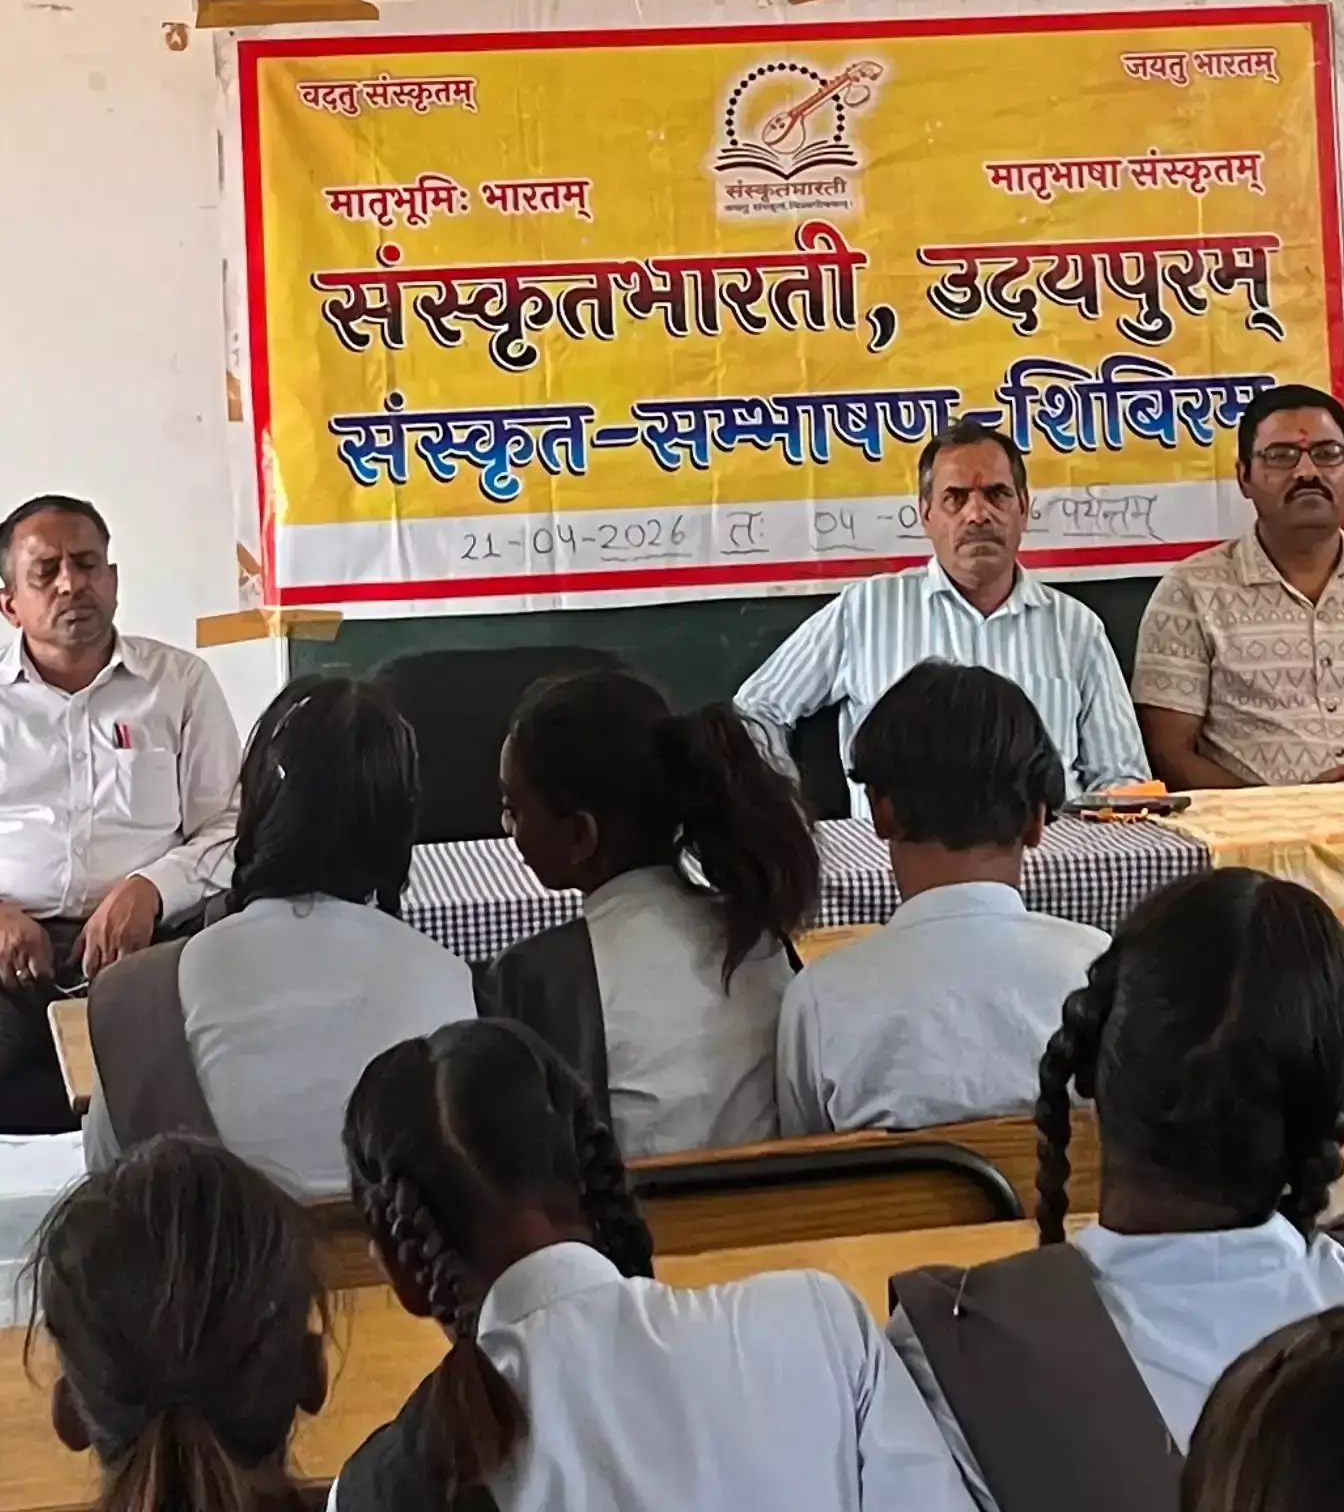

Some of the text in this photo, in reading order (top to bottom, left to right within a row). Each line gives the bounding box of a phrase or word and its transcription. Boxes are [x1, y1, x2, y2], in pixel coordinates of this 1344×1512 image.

[1123, 49, 1278, 85] जयतु भारतम्
[299, 75, 476, 114] वदतु संस्कृतम्
[725, 176, 847, 202] संस्कृतभारती
[985, 149, 1264, 199] मातृभाषा संस्कृतम्
[325, 176, 592, 226] मातृभूमिः भारतम्
[310, 219, 1286, 371] संस्कृतभारती, उदयपुरम्
[461, 515, 686, 561] 21-04-2026
